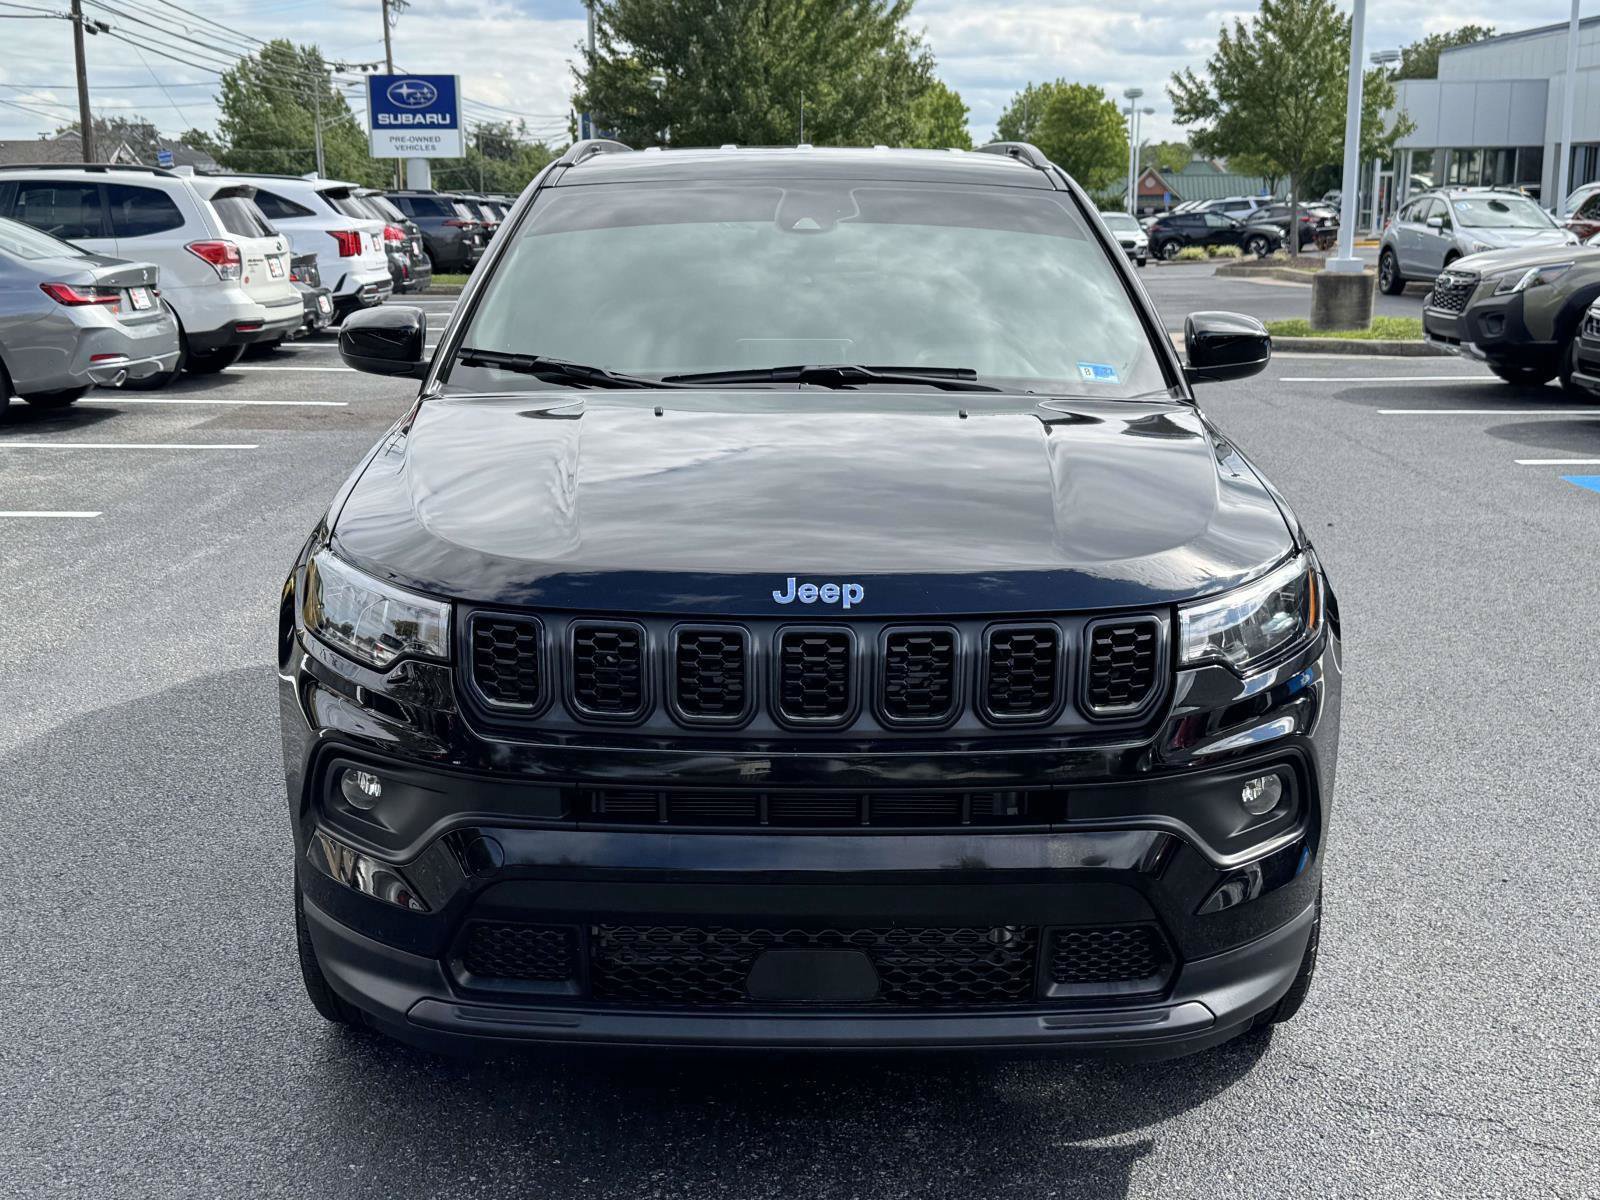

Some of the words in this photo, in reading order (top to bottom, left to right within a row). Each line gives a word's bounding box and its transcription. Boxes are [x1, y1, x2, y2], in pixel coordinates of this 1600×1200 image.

[377, 113, 451, 125] SUBARU
[389, 135, 441, 143] PRE-OWNED
[772, 577, 865, 609] Jeep
